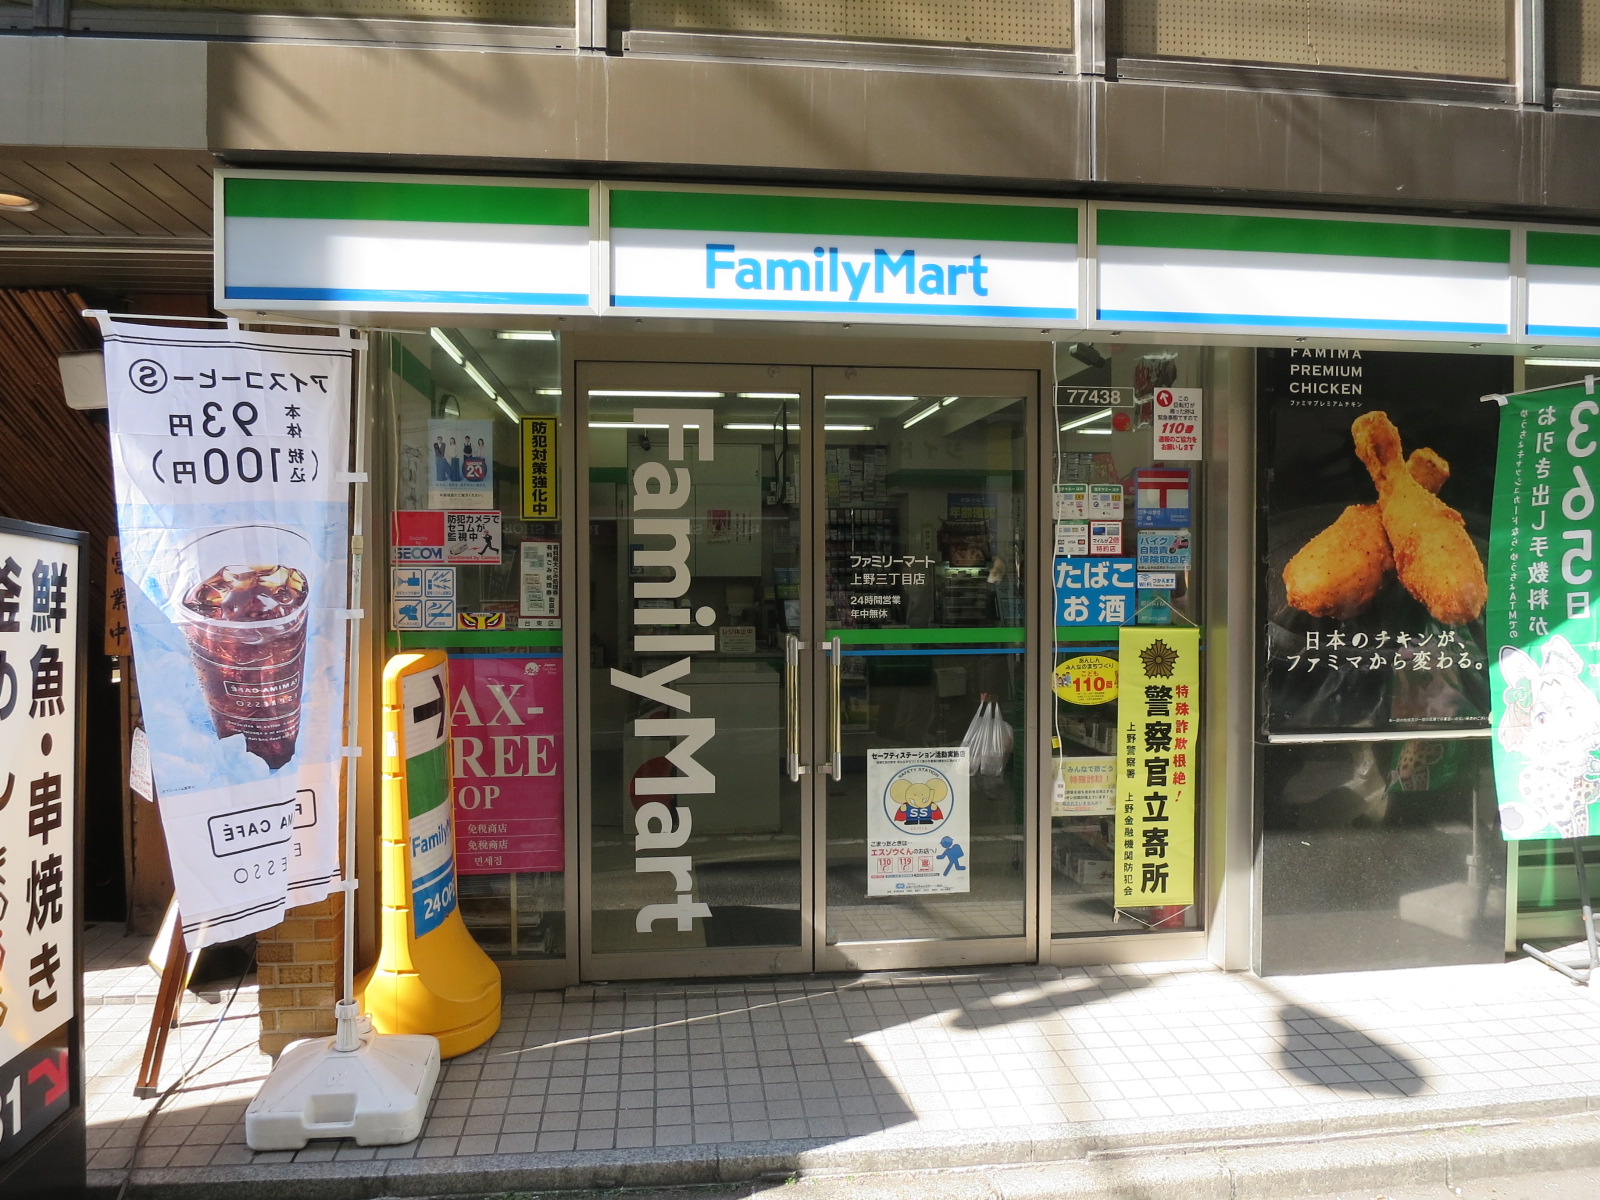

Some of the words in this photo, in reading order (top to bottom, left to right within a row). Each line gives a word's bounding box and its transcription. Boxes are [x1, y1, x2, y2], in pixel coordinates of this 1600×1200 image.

[706, 244, 988, 301] FamilyMart
[1290, 364, 1362, 378] PREMIUM
[1289, 382, 1362, 395] CHICKEN
[1066, 389, 1121, 404] 77438
[1162, 423, 1194, 434] 110番
[531, 421, 548, 515] 防犯対策強化中
[447, 514, 499, 524] 防犯カメラで
[447, 523, 485, 533] セコムが
[447, 532, 478, 542] 監視中
[1140, 537, 1168, 545] バイク
[395, 547, 443, 560] SECOM
[850, 555, 935, 568] ファミリーマート
[850, 573, 926, 585] 上野三丁目店
[1056, 562, 1134, 589] たばこ
[850, 595, 901, 606] 24時間営業
[850, 609, 888, 619] 年中無休
[1063, 595, 1125, 623] お酒
[1305, 630, 1469, 652] 日本のチキンが、
[1286, 651, 1483, 673] ファミマから変わる。
[610, 408, 716, 933] FamilyMart
[871, 750, 966, 760] セーフティステーション活動実施店
[1126, 722, 1136, 779] 上野警察署
[27, 559, 67, 1012] 鮮魚・串焼き
[1140, 685, 1172, 893] 警察官立寄所
[453, 785, 501, 810] OP
[909, 808, 928, 818] SS
[1123, 792, 1134, 896] 上野金融機関防犯会
[474, 855, 503, 866] 면세점
